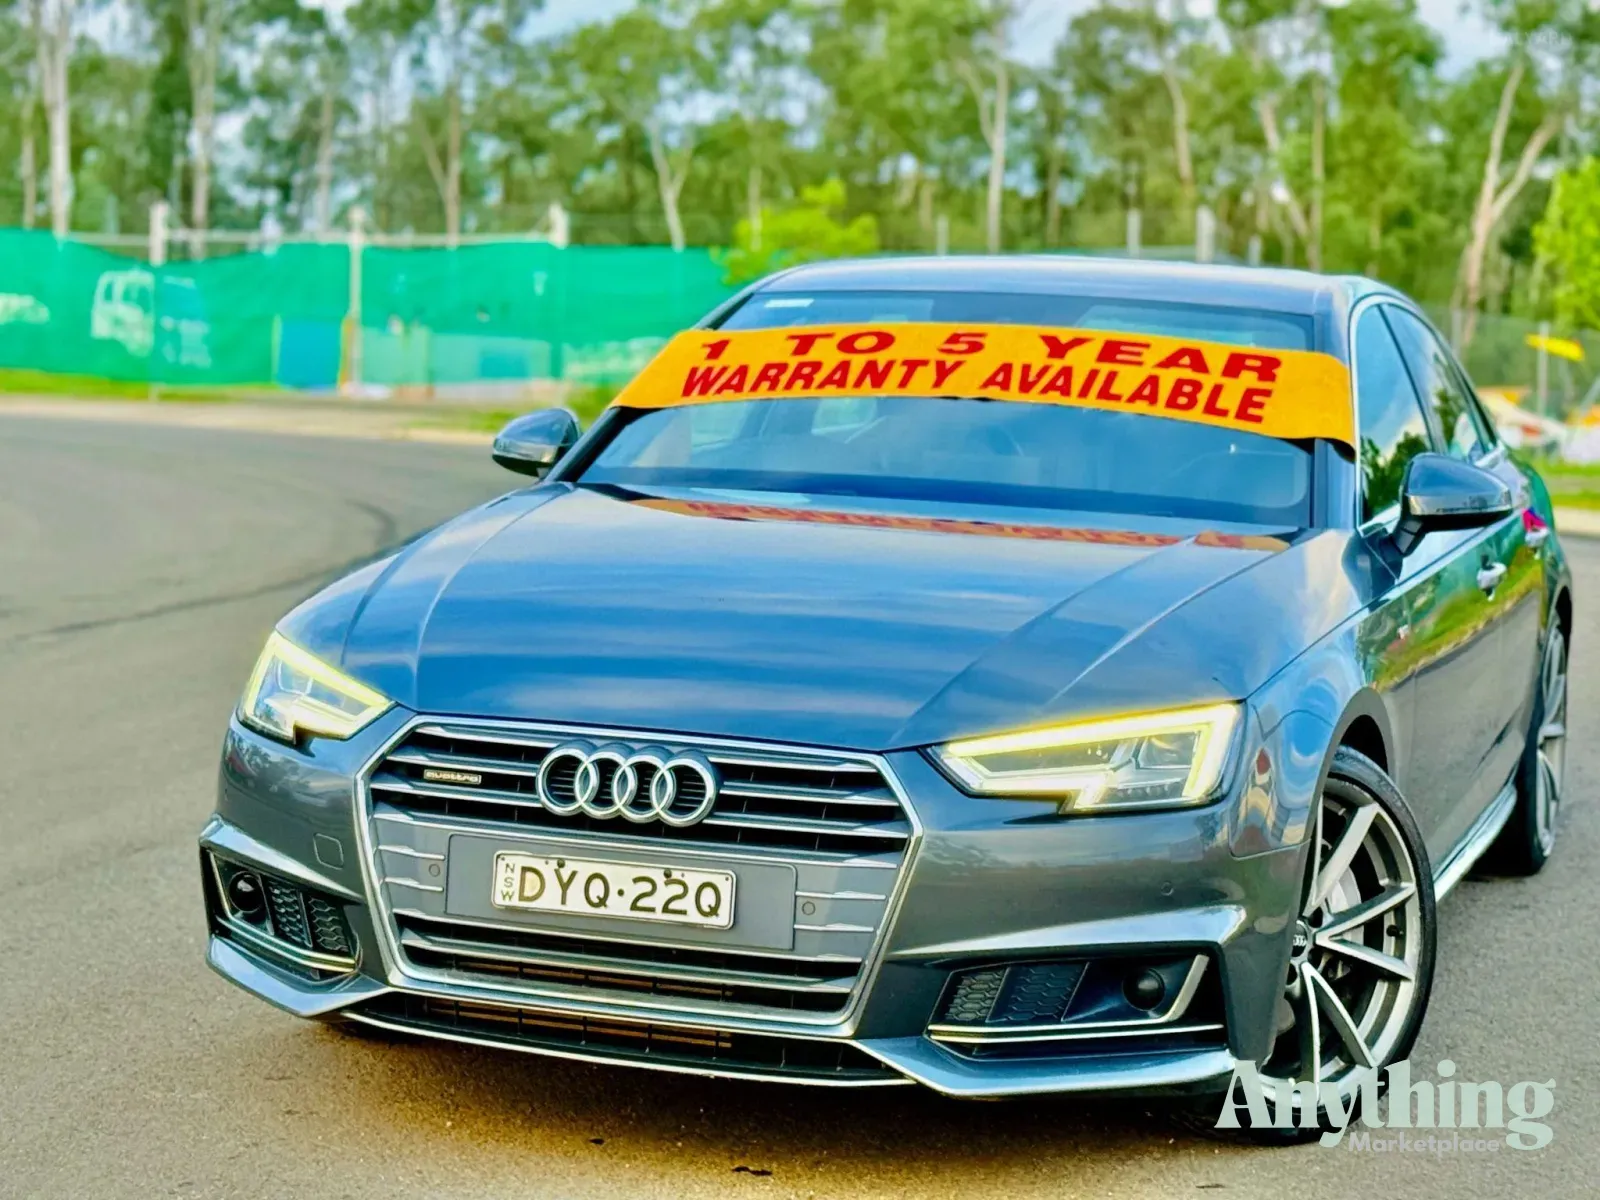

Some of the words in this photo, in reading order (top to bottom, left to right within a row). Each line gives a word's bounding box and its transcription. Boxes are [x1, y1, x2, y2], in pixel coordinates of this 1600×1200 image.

[702, 339, 732, 360] 1
[786, 331, 896, 357] TO
[937, 332, 988, 355] 5
[1039, 334, 1282, 382] YEAR
[681, 359, 966, 397] WARRANTY
[979, 362, 1274, 424] AVAILABLE
